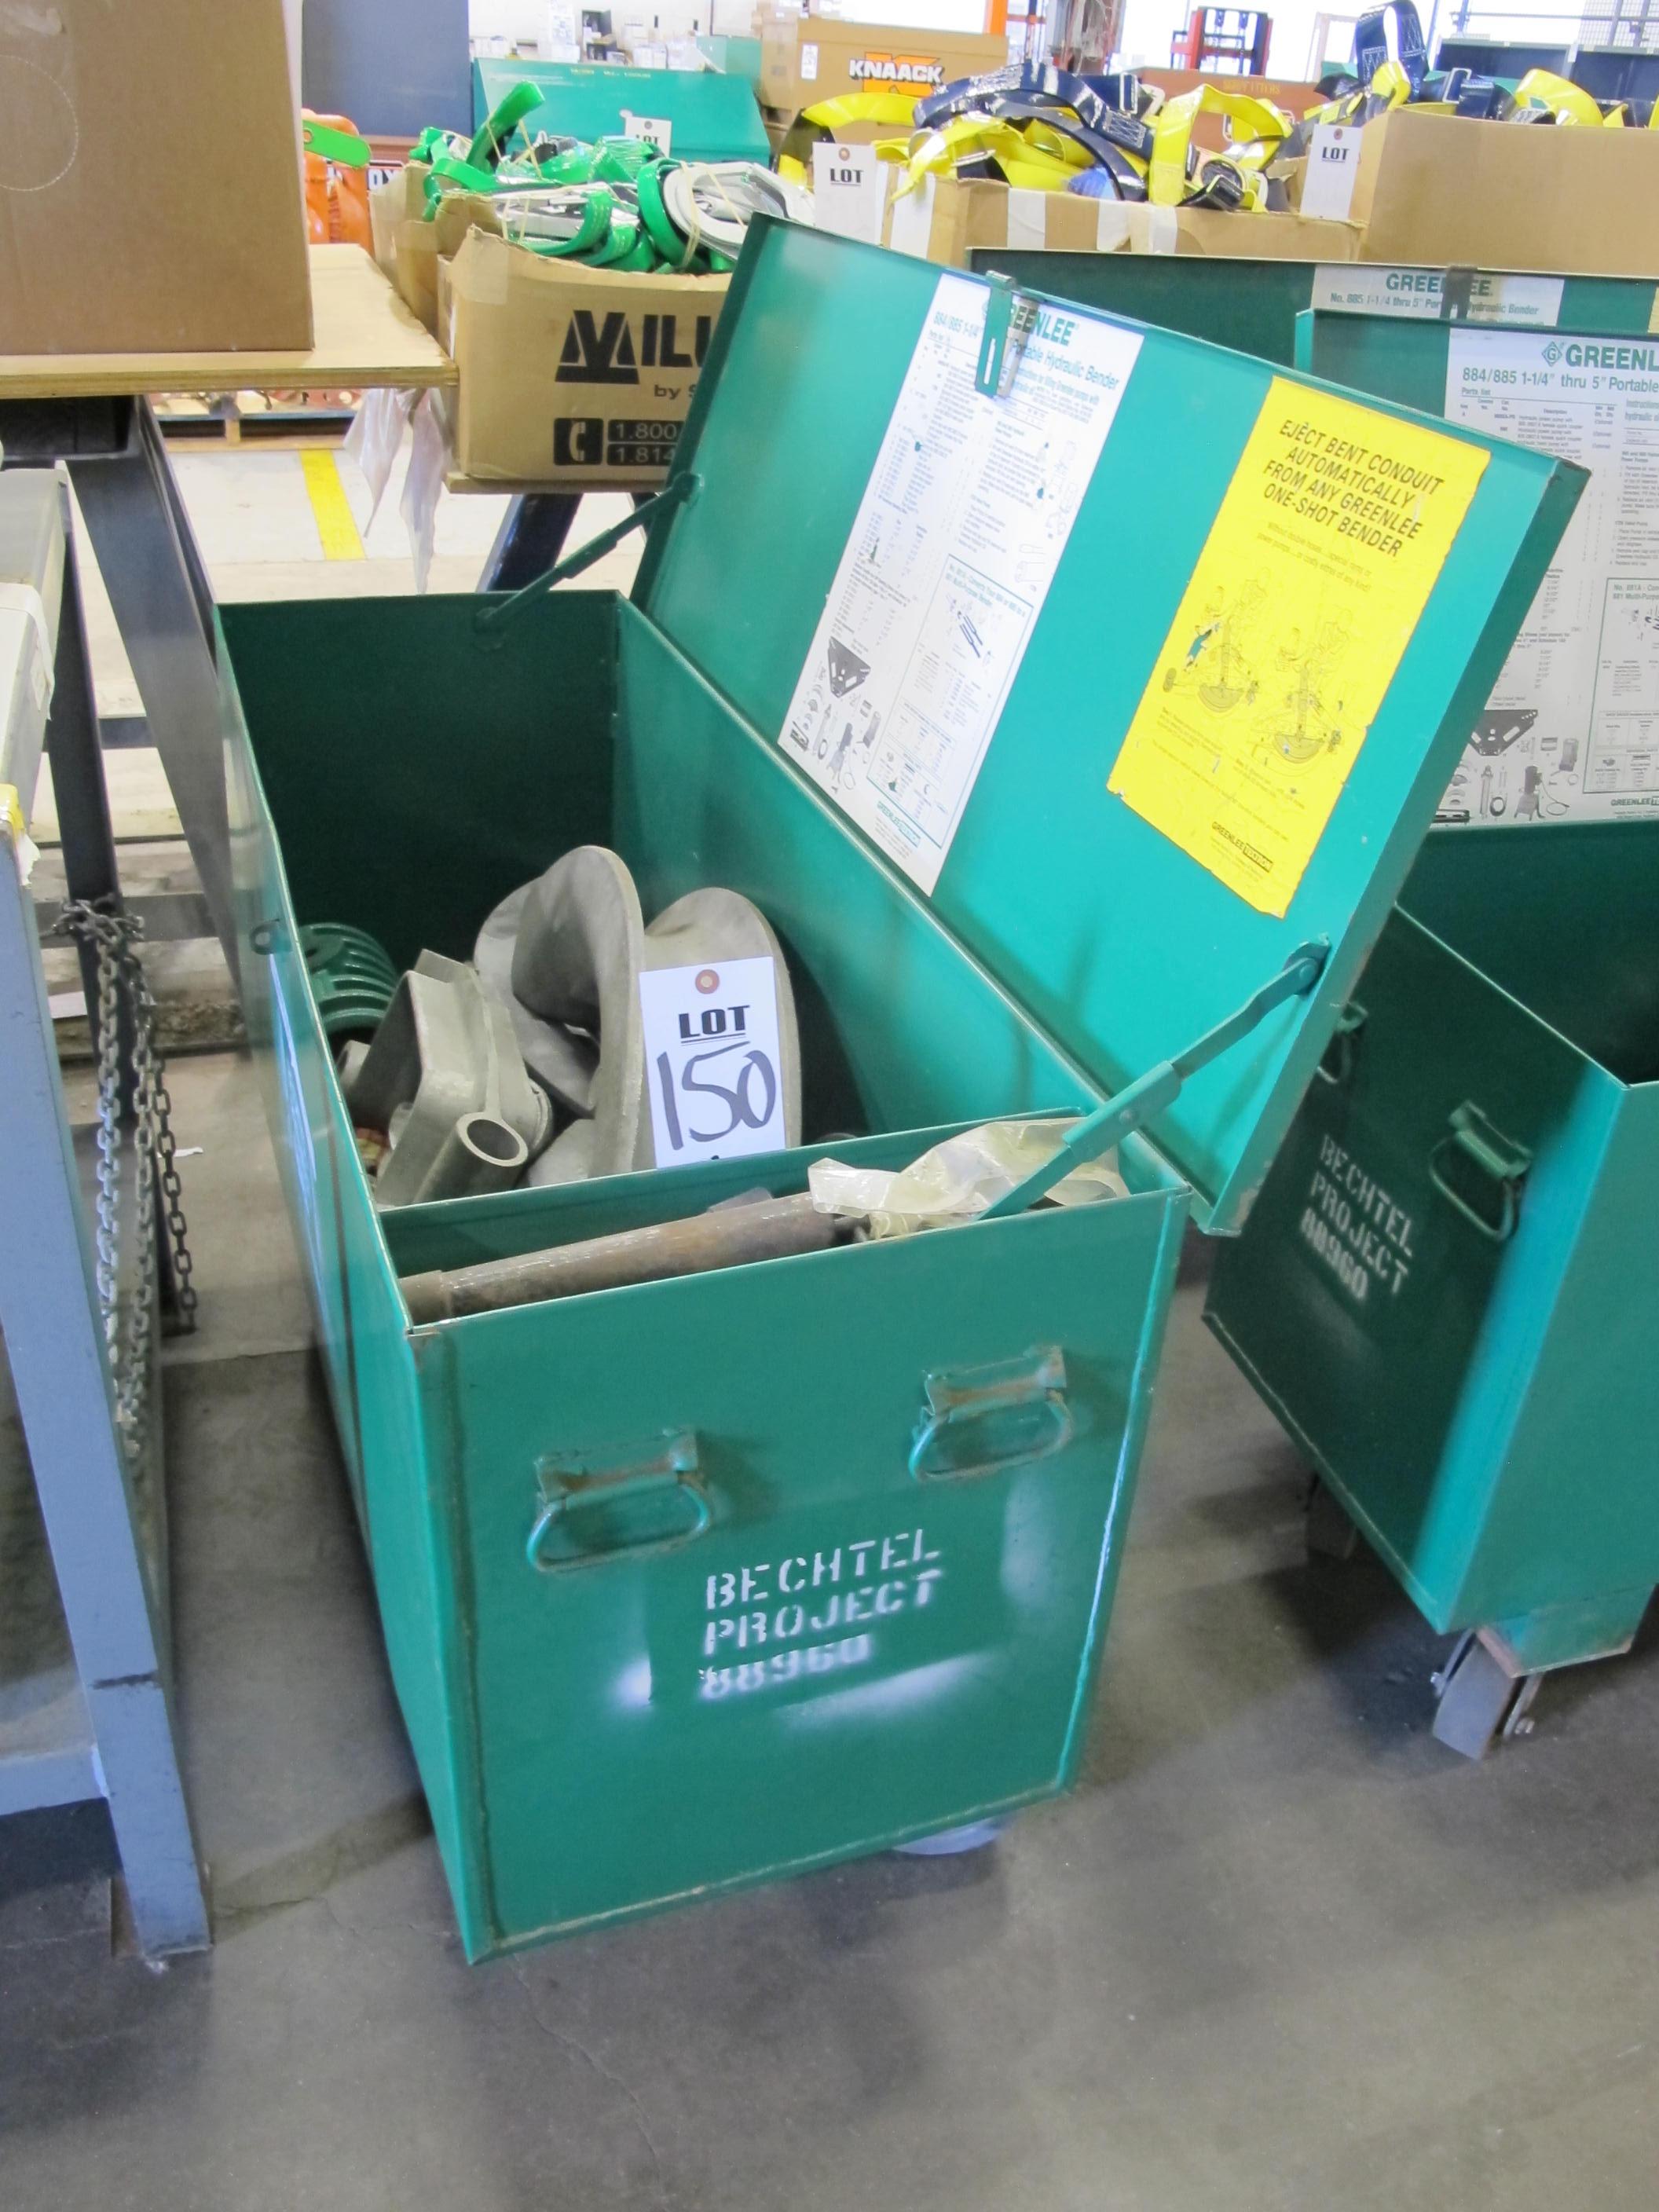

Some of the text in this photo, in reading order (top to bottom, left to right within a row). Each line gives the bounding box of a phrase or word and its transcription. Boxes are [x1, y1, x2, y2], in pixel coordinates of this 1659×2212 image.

[848, 59, 943, 83] KNAACK
[830, 167, 864, 183] LOT
[1322, 146, 1350, 160] LOT
[1468, 301, 1505, 314] ydraulic
[654, 384, 681, 400] by
[1463, 367, 1518, 384] 884/885
[1561, 374, 1587, 389] thru
[1609, 376, 1659, 393] Portable
[616, 423, 677, 440] 1.800
[1279, 419, 1445, 496] EJECT BENT CONDUIT
[1263, 460, 1423, 540] FROM ANY GREENLEE
[1285, 447, 1416, 510] AUTOMATICALLY
[1263, 482, 1404, 558] ONE-SHOT BENDER
[678, 1005, 751, 1039] LOT
[656, 1041, 777, 1151] 150
[1320, 1133, 1413, 1258] BECHTEL
[1310, 1170, 1410, 1294] PROJECT
[705, 1528, 941, 1610] BECHTEL
[704, 1569, 943, 1656] PROJECT
